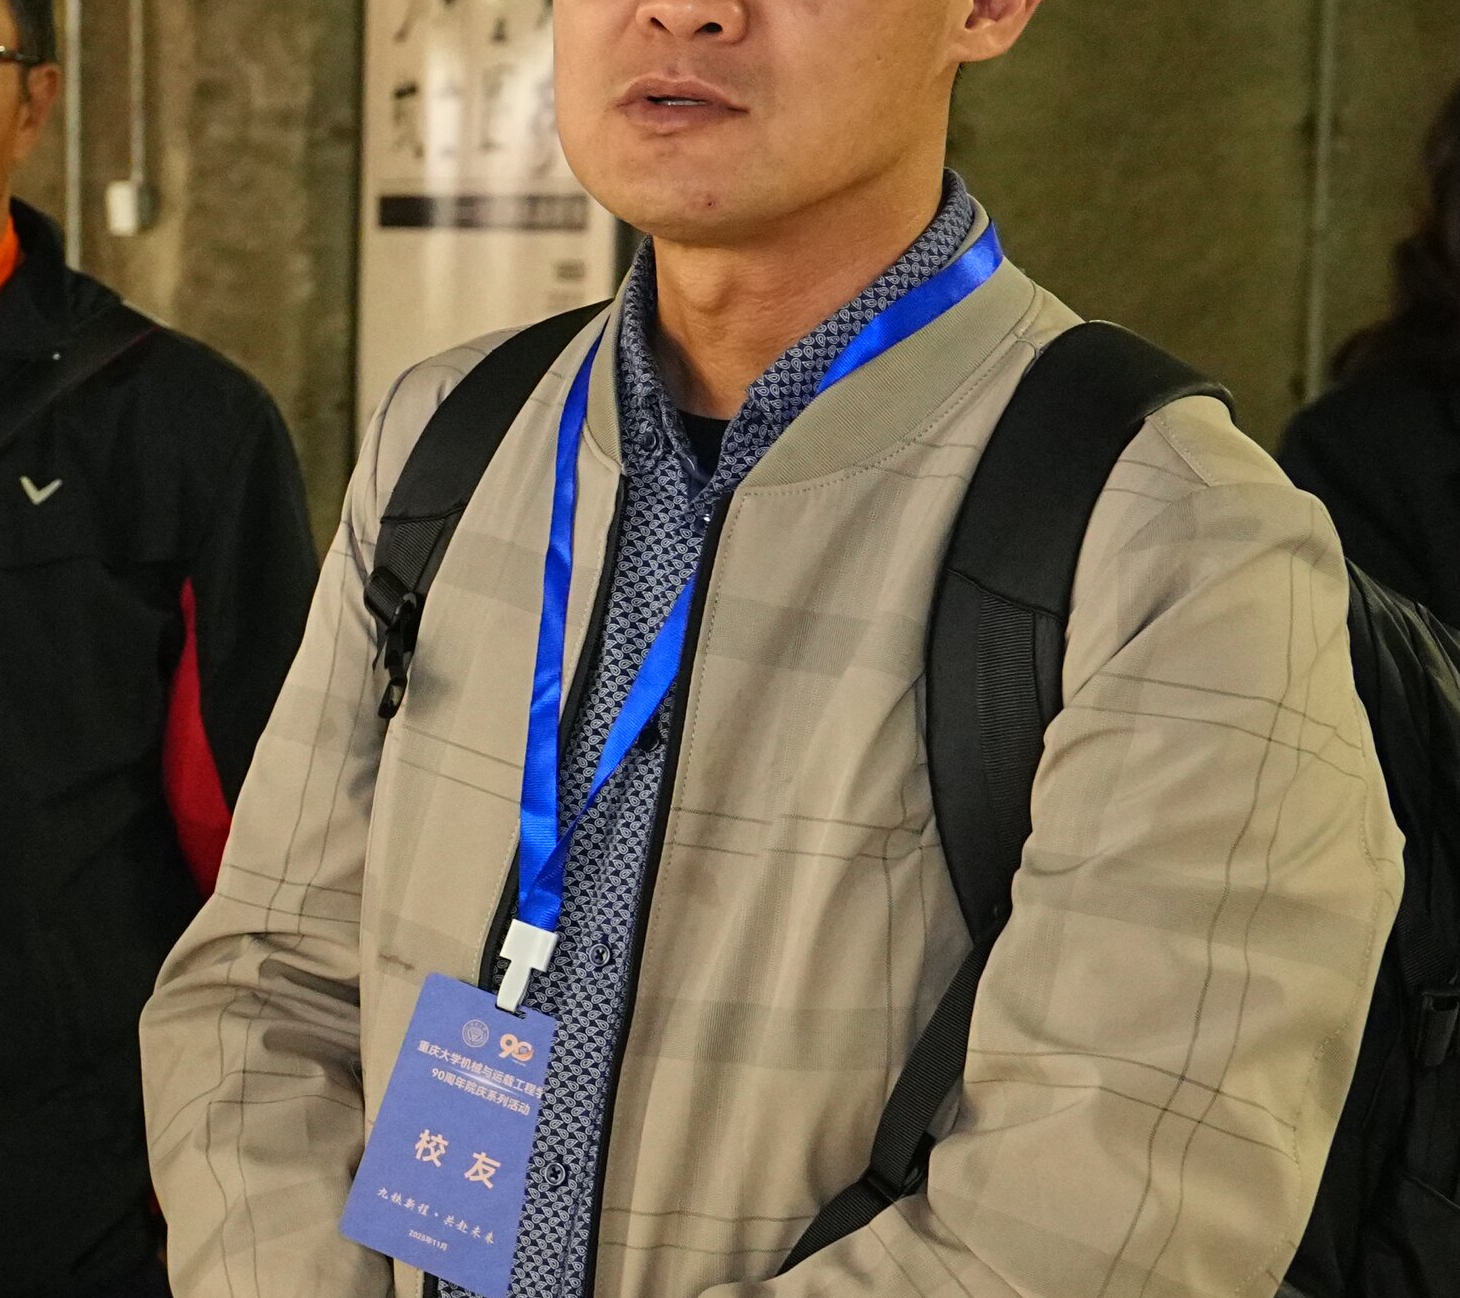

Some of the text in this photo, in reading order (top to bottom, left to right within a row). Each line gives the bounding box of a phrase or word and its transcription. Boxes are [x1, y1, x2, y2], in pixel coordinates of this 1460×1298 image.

[499, 1034, 534, 1061] 90
[432, 1068, 531, 1116] 90周年院庆系列活动
[415, 1129, 501, 1189] 校友
